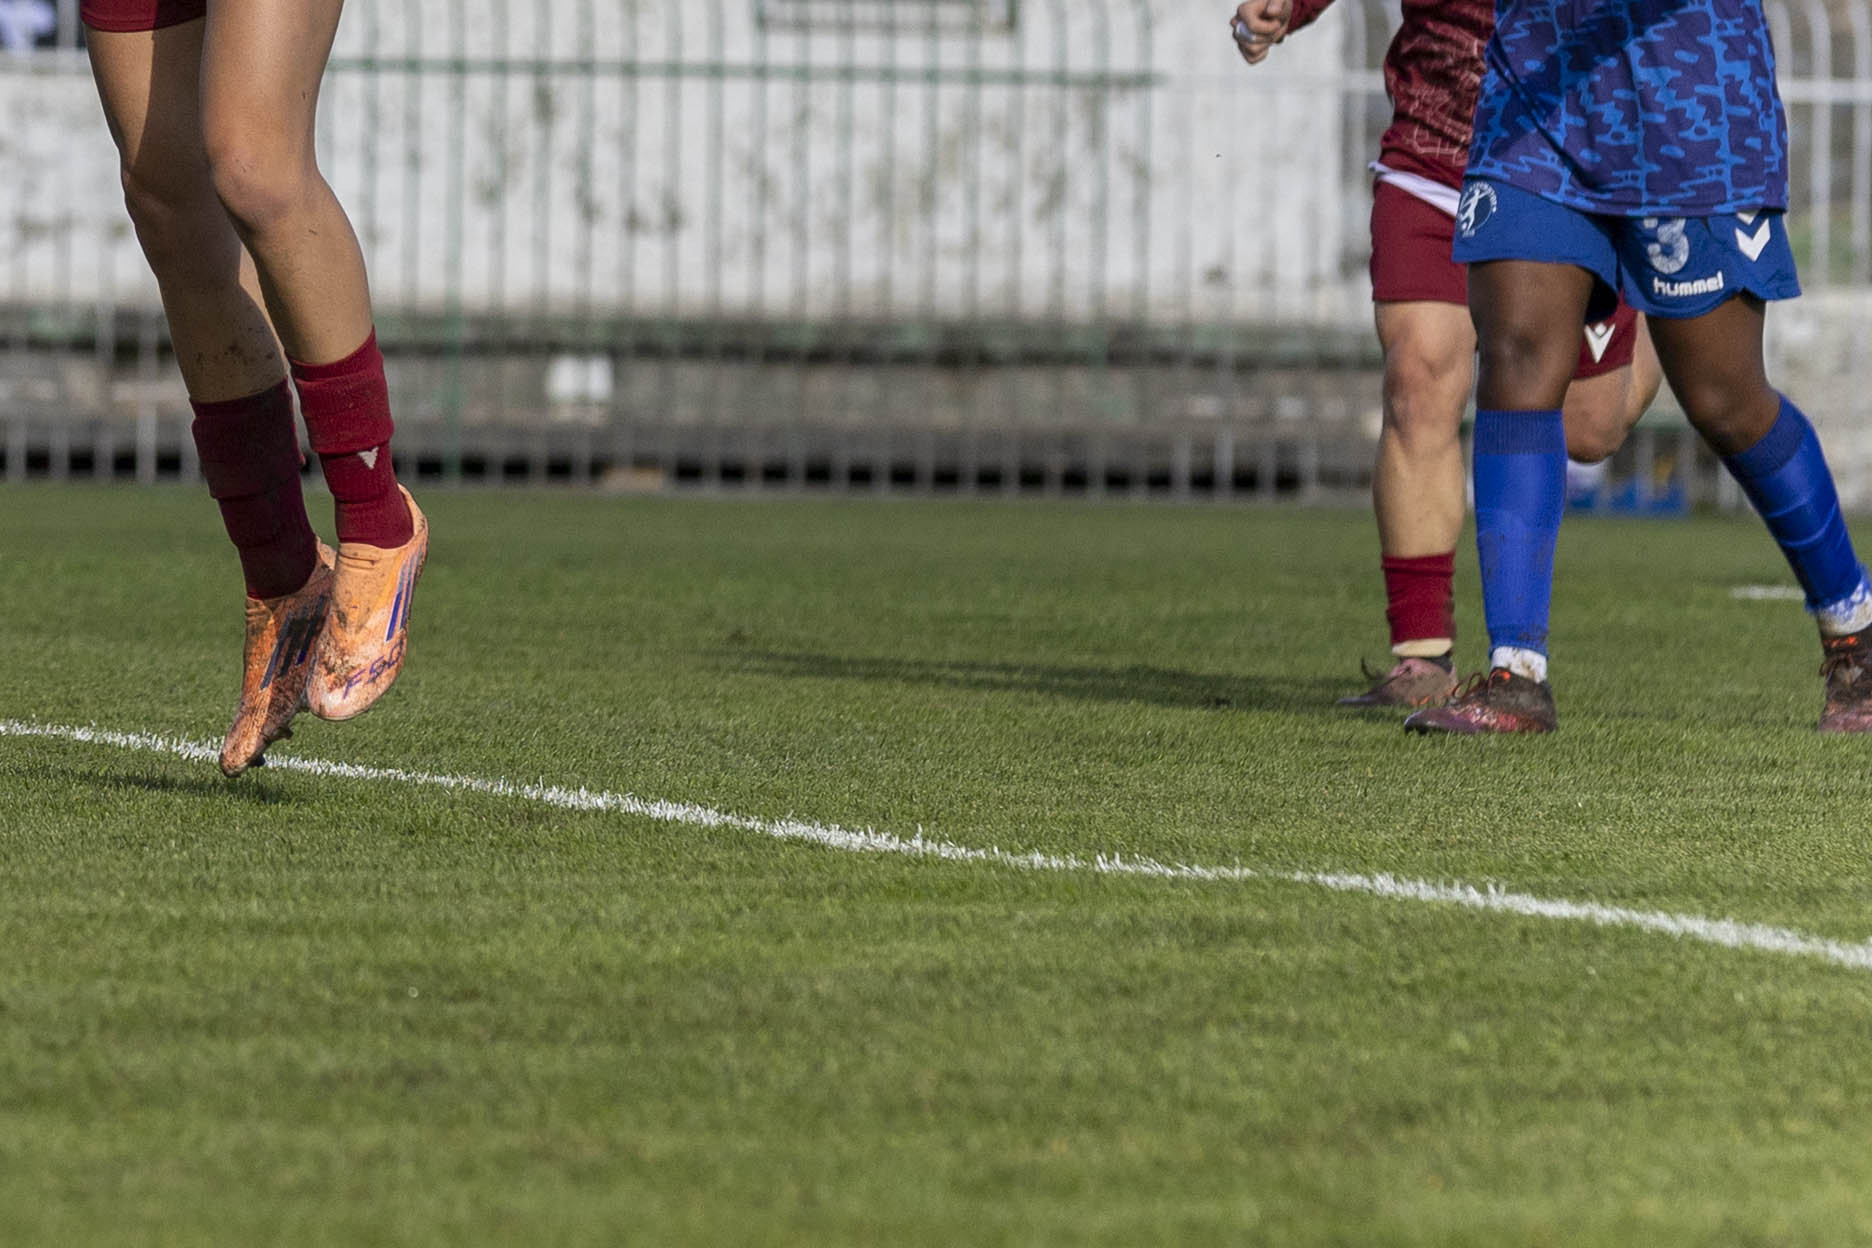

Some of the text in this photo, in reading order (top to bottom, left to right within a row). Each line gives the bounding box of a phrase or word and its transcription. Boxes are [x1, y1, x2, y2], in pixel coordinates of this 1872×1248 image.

[1643, 218, 1689, 274] 3
[1653, 270, 1724, 296] hummel
[342, 638, 404, 700] F50
